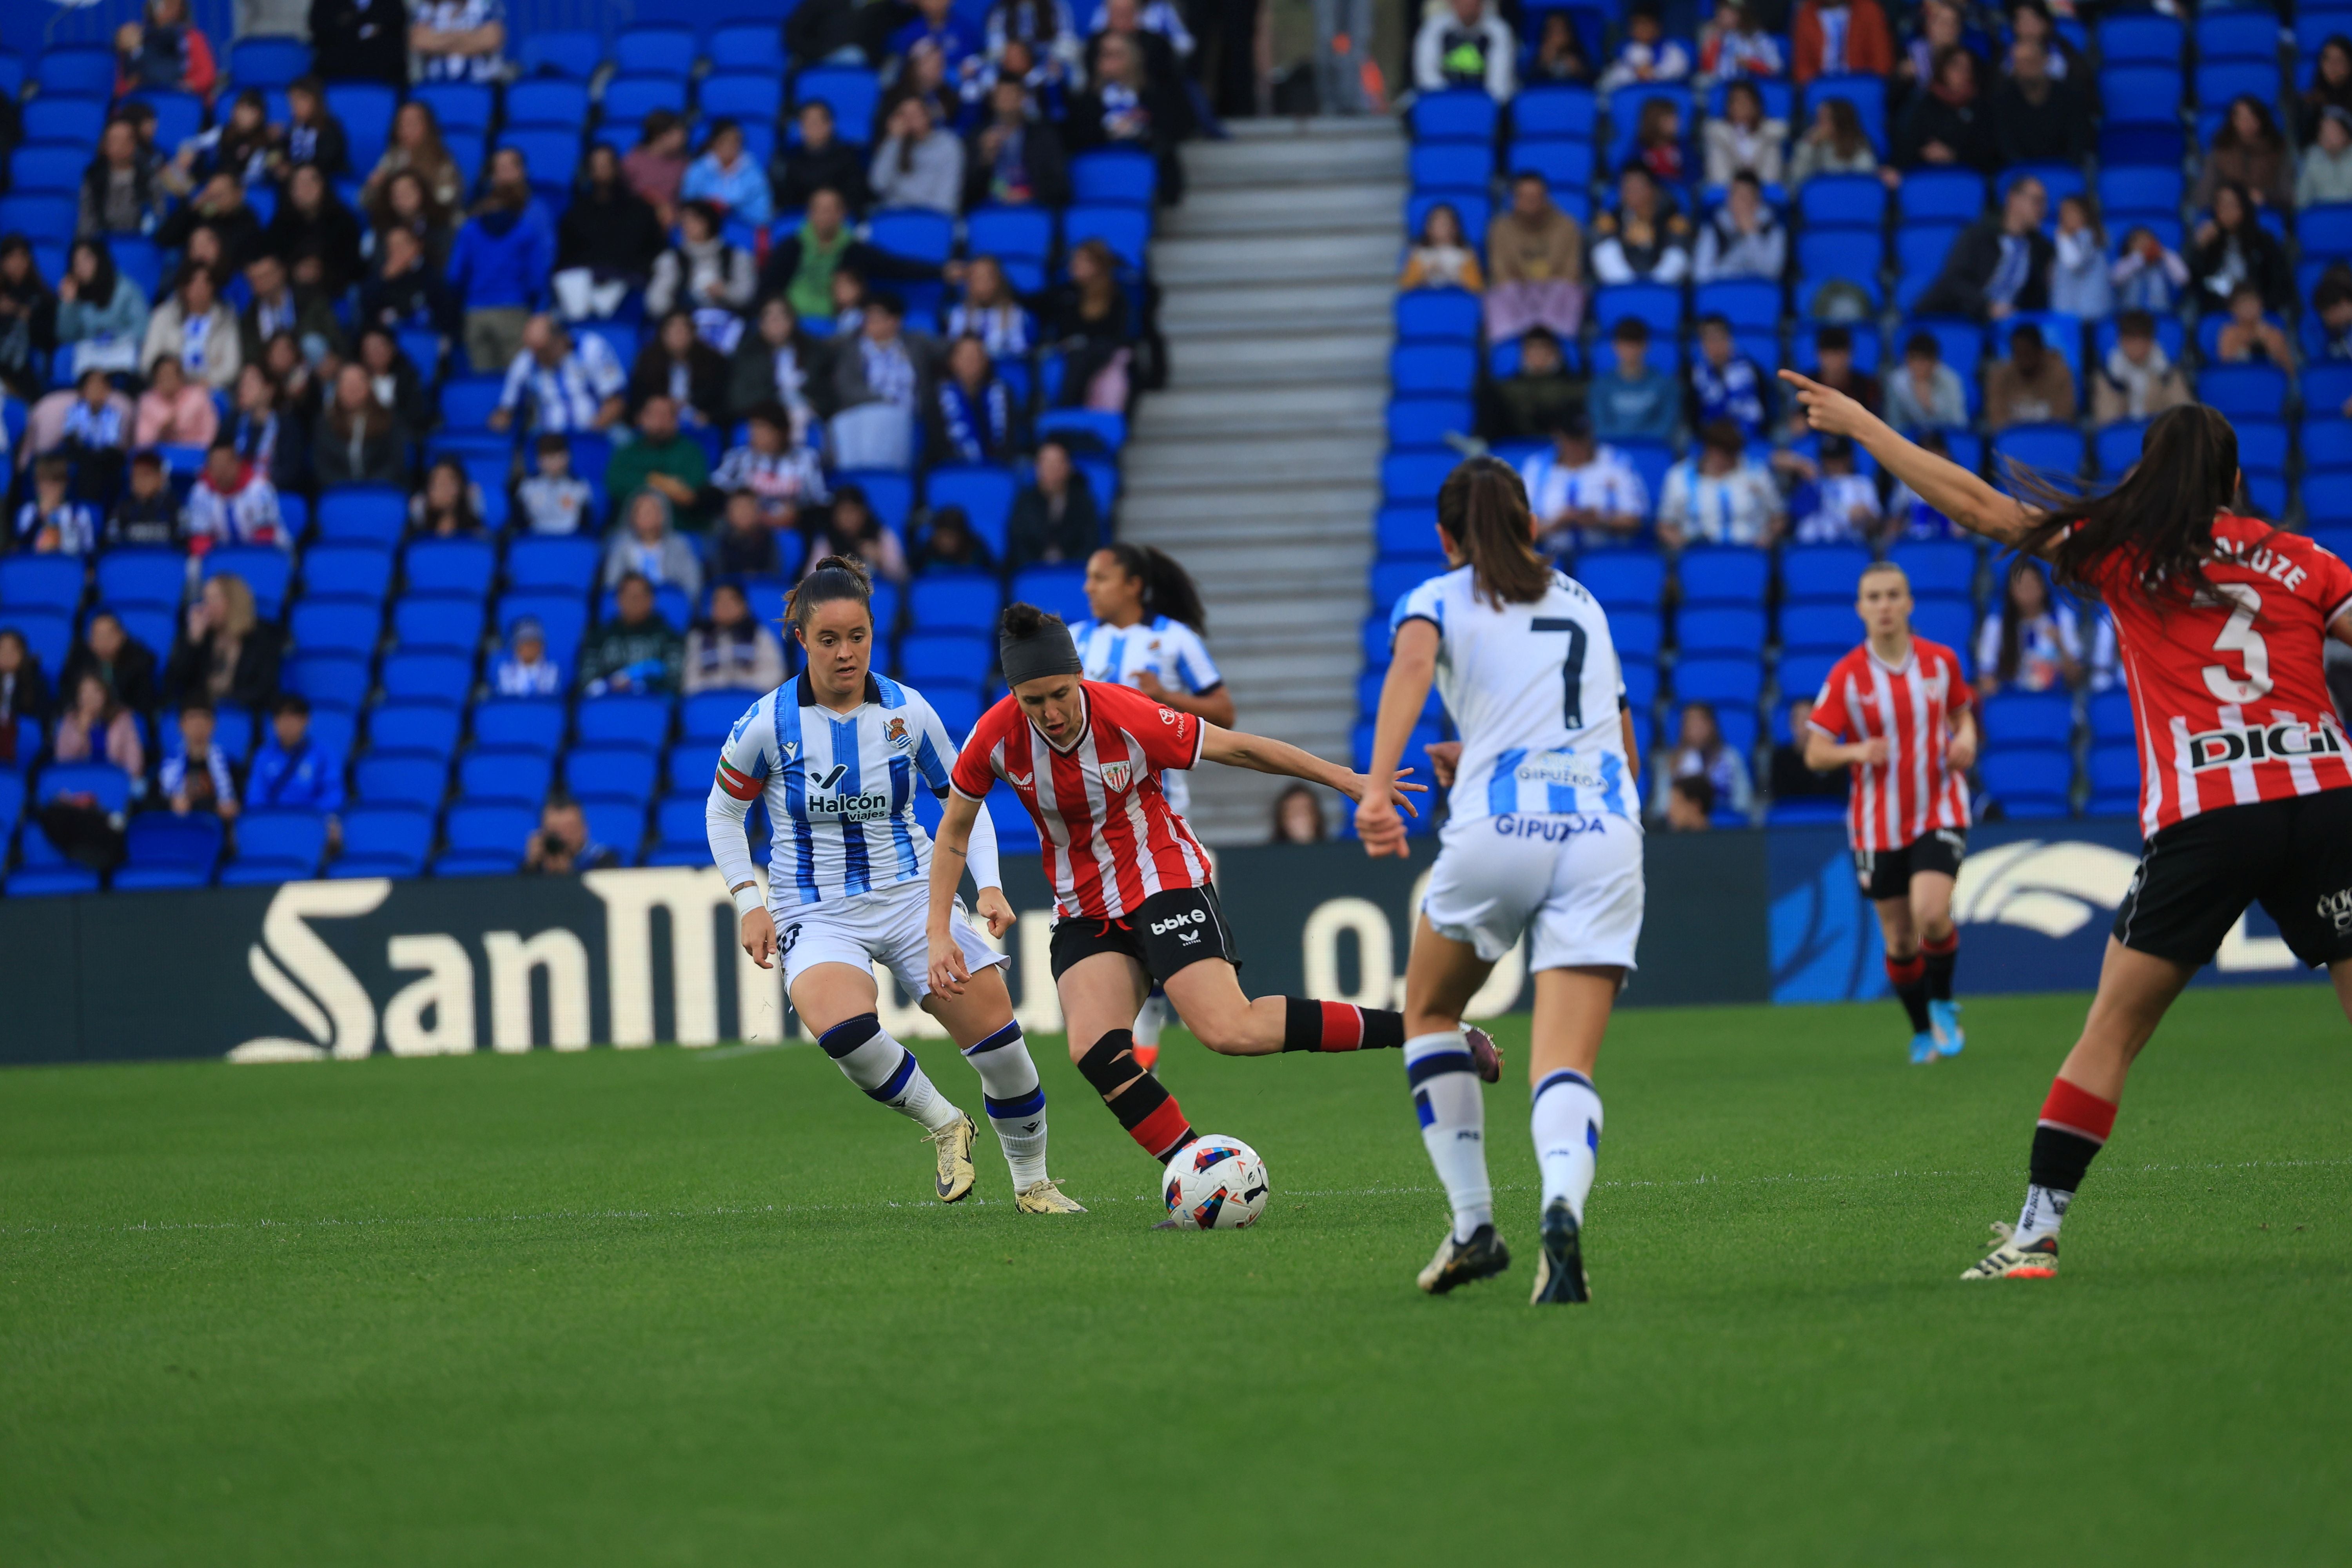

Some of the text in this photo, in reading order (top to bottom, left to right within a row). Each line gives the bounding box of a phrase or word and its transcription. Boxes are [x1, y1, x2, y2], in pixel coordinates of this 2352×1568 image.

[2190, 583, 2274, 704] 3
[1530, 617, 1587, 730] 7
[2190, 725, 2340, 768] DIGI
[809, 792, 886, 812] Halcón
[849, 810, 885, 820] viajes
[1151, 914, 1192, 935] bbk
